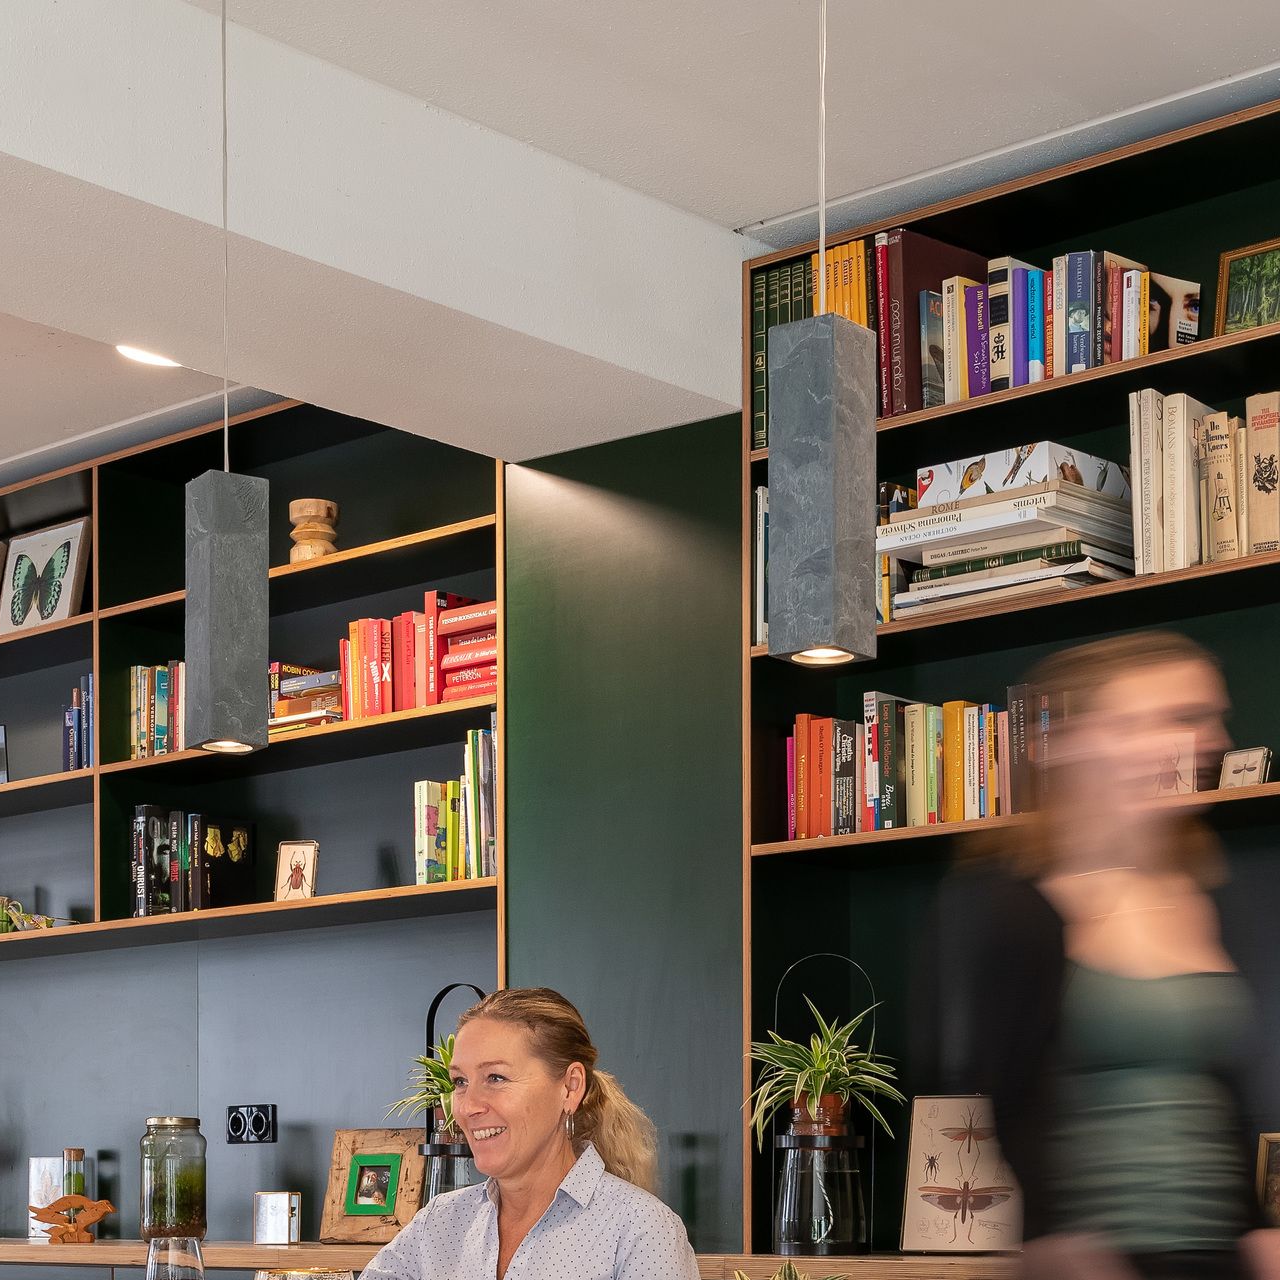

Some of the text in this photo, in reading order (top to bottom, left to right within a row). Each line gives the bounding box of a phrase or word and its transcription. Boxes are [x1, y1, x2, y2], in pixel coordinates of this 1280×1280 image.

[976, 290, 985, 330] Jill Mansell
[1167, 406, 1177, 449] BOMANS
[931, 501, 960, 514] ROME
[1013, 496, 1047, 509] Artemis
[920, 513, 962, 529] Panorama
[381, 632, 390, 682] SPELER X
[282, 665, 301, 675] ROBIN
[370, 661, 379, 684] MINI
[452, 673, 481, 683] PETERSON
[883, 704, 891, 721] Loes
[884, 740, 892, 777] Hollander
[885, 784, 894, 807] Broei
